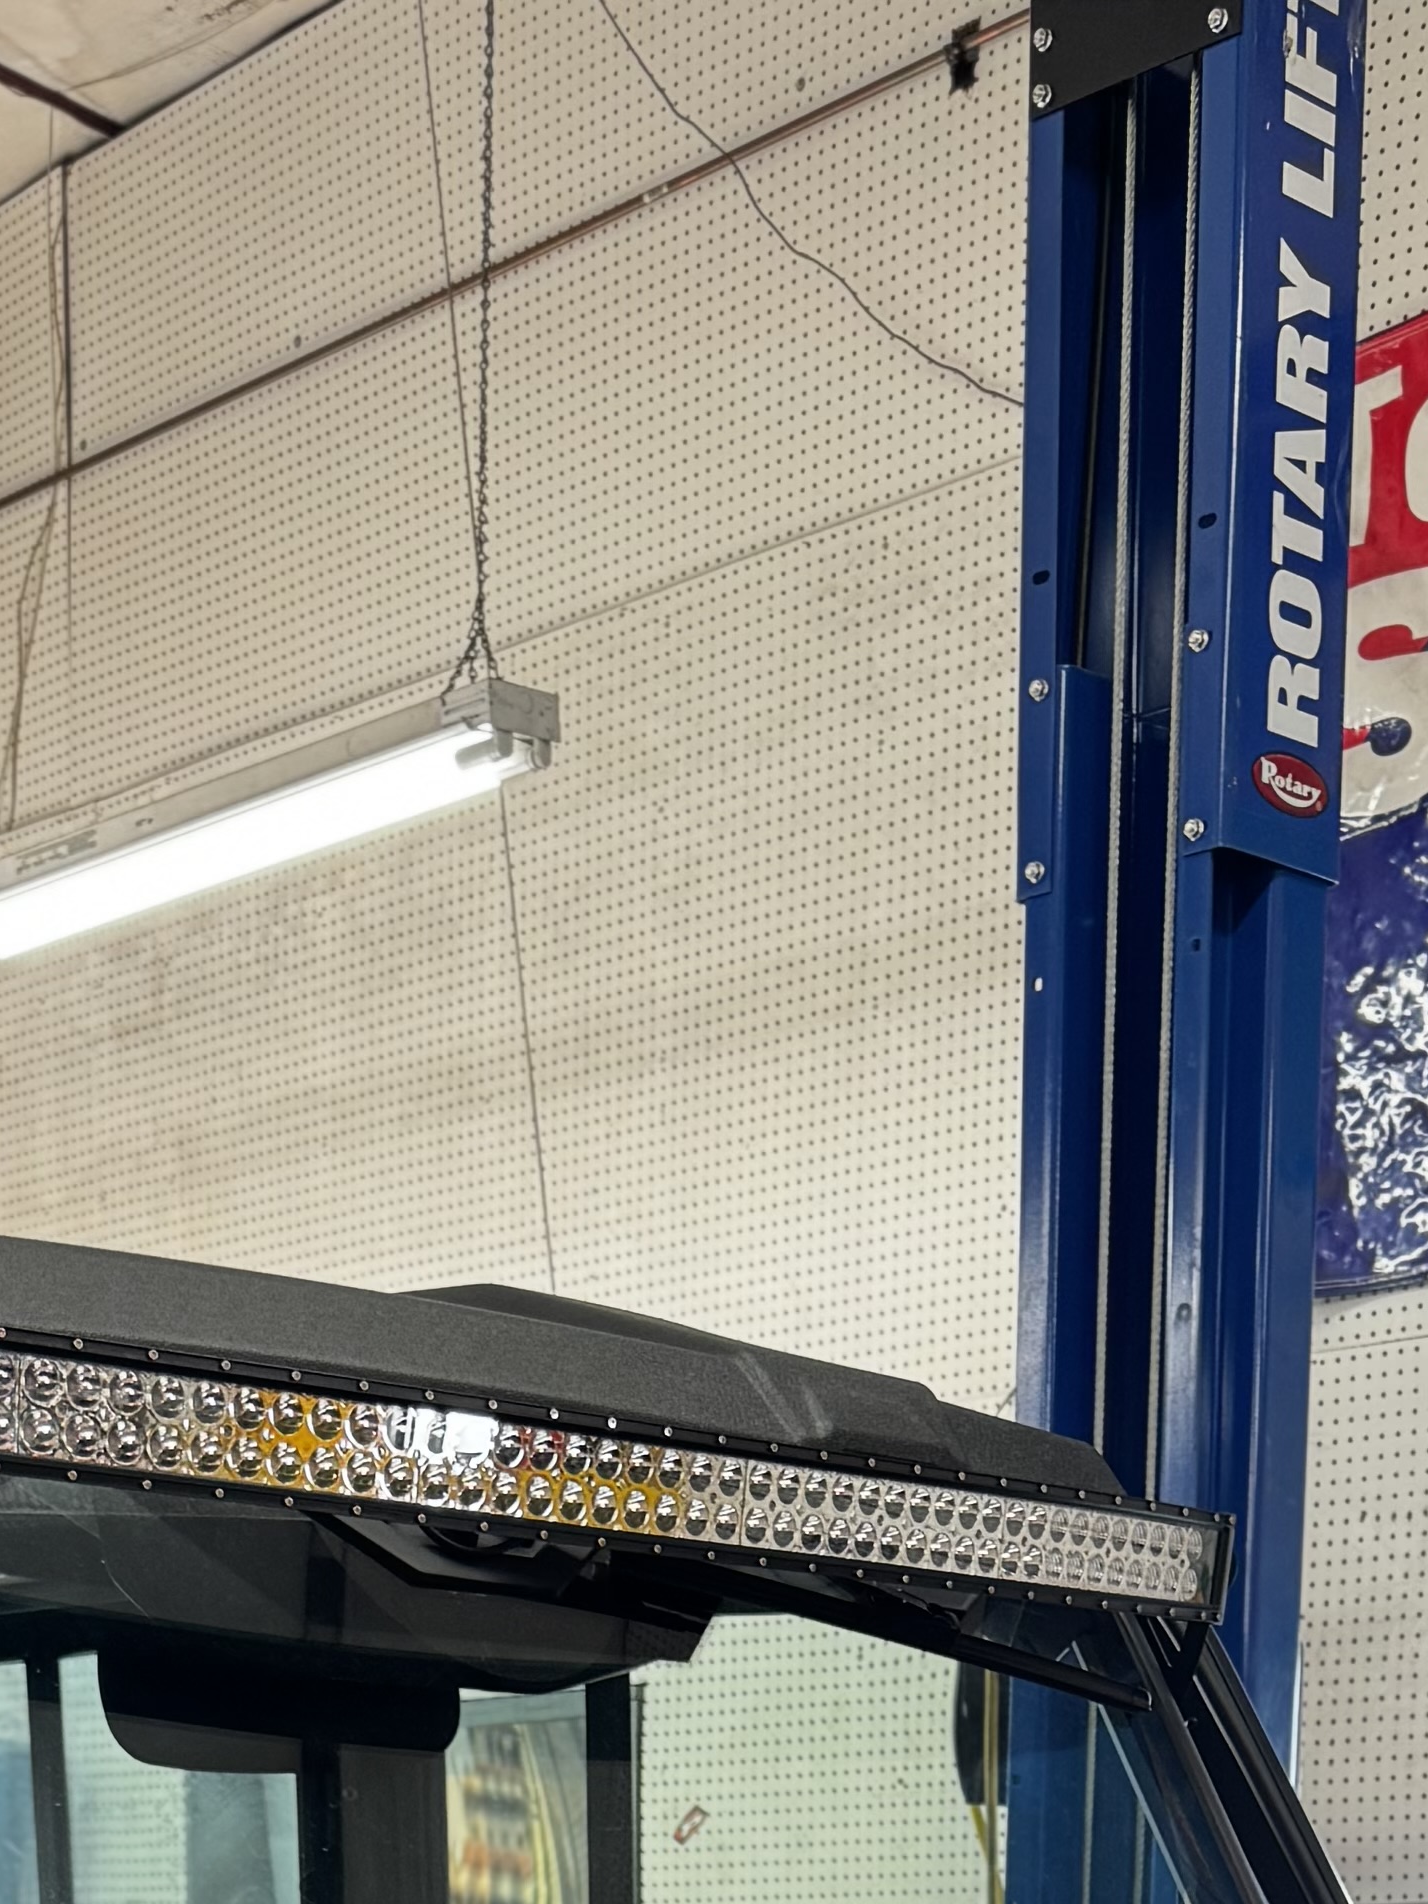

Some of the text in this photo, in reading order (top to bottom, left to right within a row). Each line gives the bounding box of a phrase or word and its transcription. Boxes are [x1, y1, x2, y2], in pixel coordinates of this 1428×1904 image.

[1266, 0, 1341, 748] ROTARY LIF
[1260, 756, 1322, 803] Rotary
